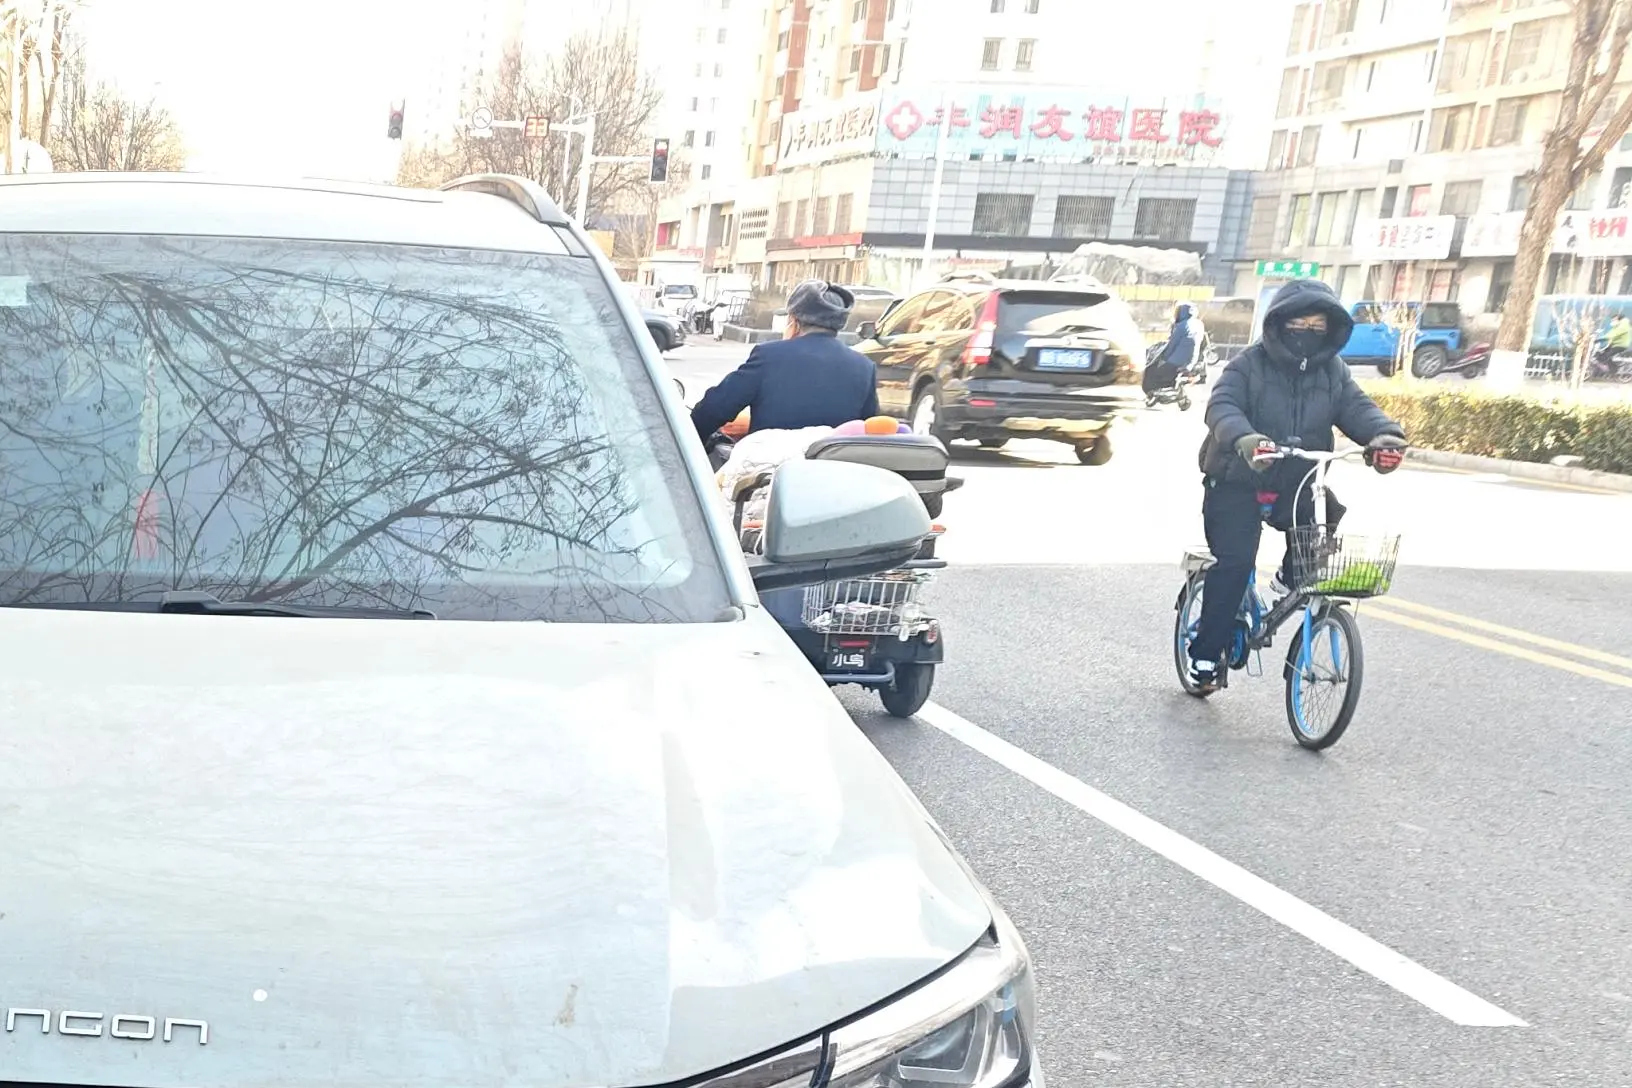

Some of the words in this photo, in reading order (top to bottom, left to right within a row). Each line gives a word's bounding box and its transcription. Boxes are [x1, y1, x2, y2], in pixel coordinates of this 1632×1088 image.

[926, 102, 1224, 147] 丰润友谊医院
